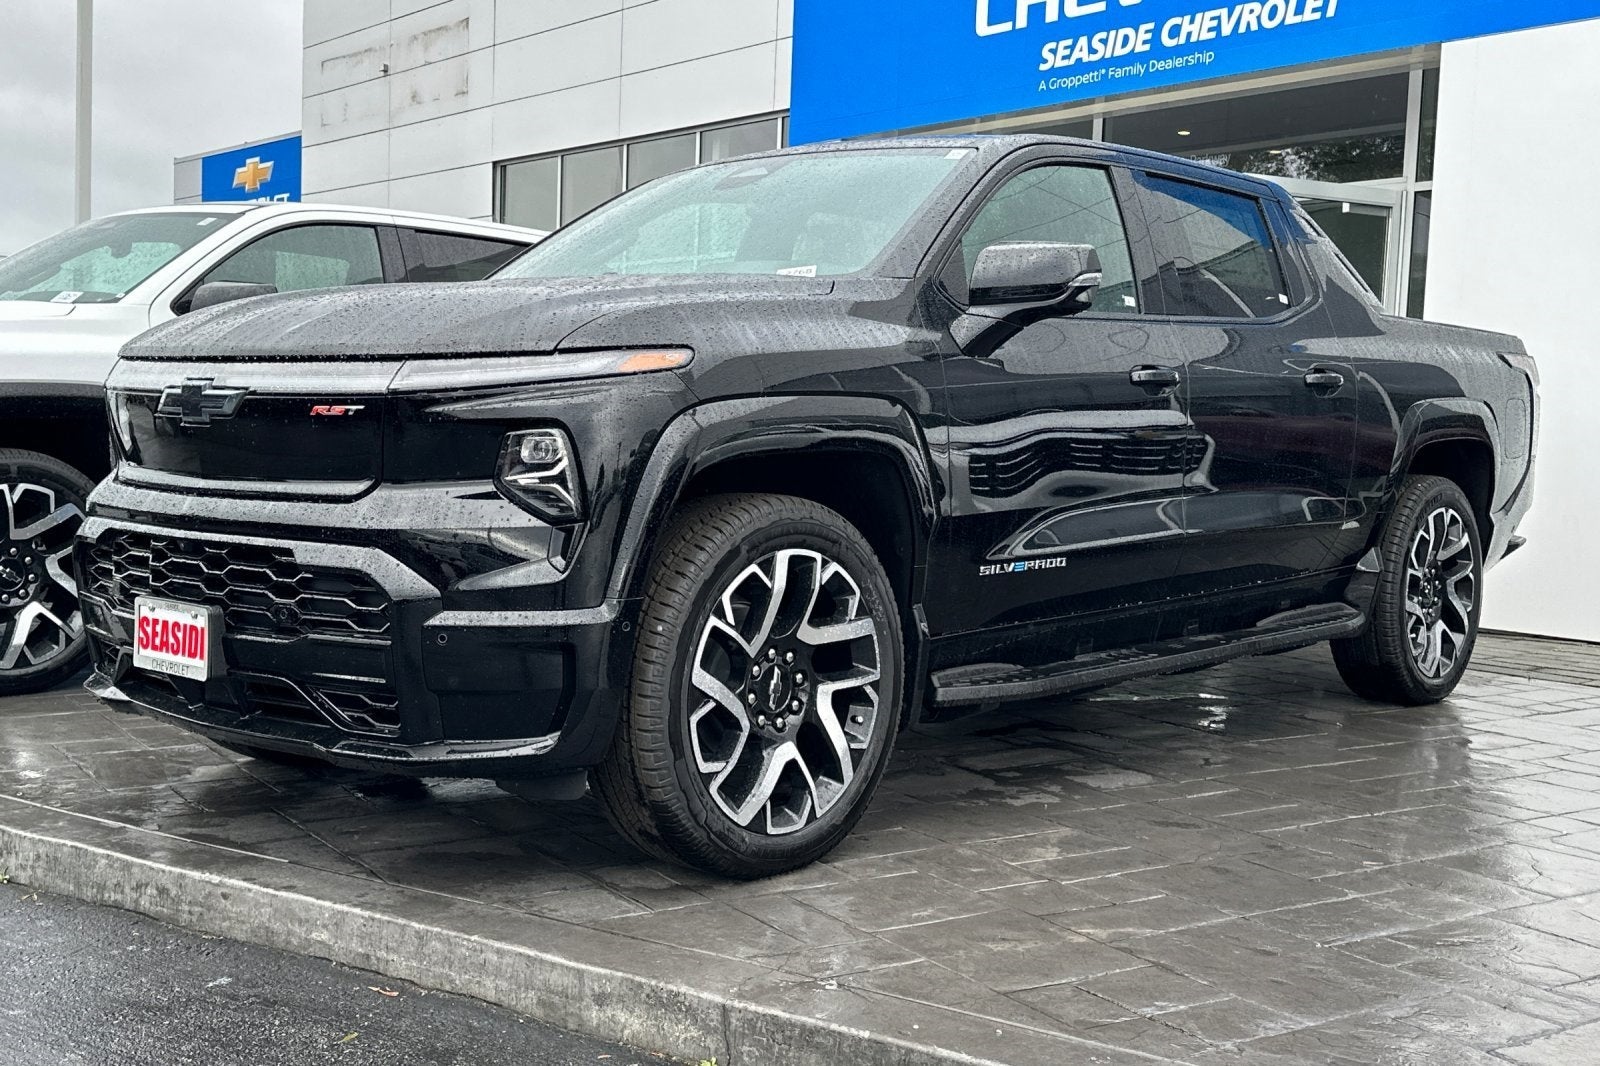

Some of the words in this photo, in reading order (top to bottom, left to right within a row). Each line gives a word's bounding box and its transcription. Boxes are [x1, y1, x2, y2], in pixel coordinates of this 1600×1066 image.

[1038, 23, 1155, 71] SEASIDE
[1161, 0, 1339, 47] CHEVROLET
[1038, 81, 1047, 91] A
[1108, 61, 1147, 81] Family
[1149, 49, 1215, 73] Dealership
[310, 405, 366, 416] RST
[979, 557, 1067, 576] SILVERADO
[151, 660, 190, 676] CHEVROLET
